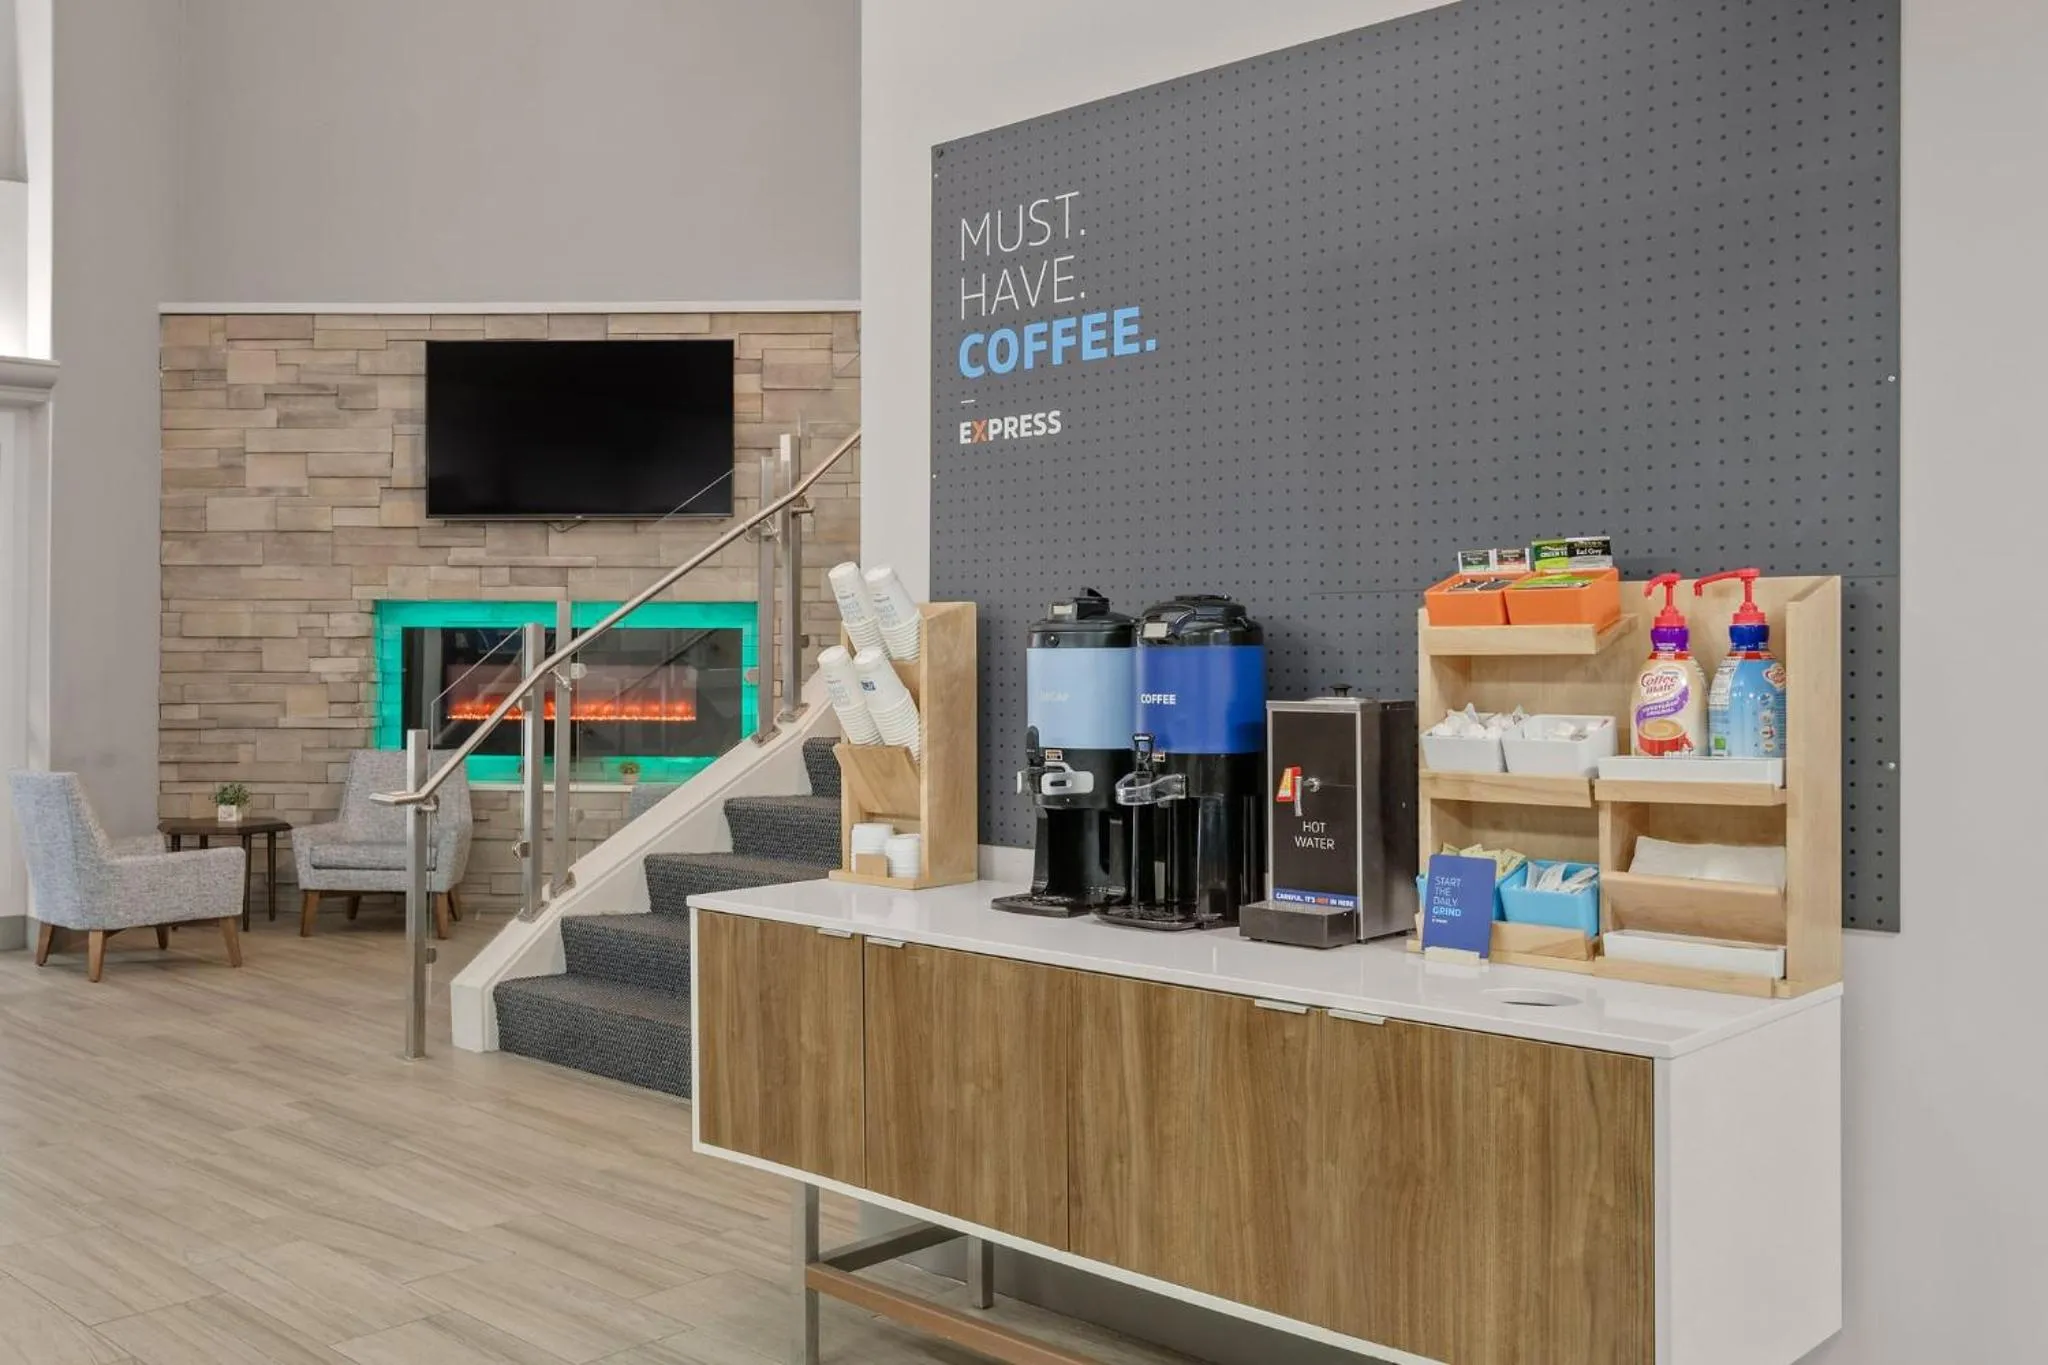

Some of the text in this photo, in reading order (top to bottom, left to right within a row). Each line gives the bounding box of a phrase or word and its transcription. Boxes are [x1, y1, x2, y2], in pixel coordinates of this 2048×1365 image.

[960, 191, 1087, 261] MUST.
[960, 255, 1086, 320] HAVE.
[958, 306, 1158, 380] COFFEE.
[959, 410, 1062, 445] EXPRESS
[1140, 693, 1177, 705] COFFEE
[1302, 820, 1327, 833] HOT
[1294, 836, 1335, 850] WATER
[1435, 887, 1452, 897] THE
[1432, 906, 1462, 917] GRIND
